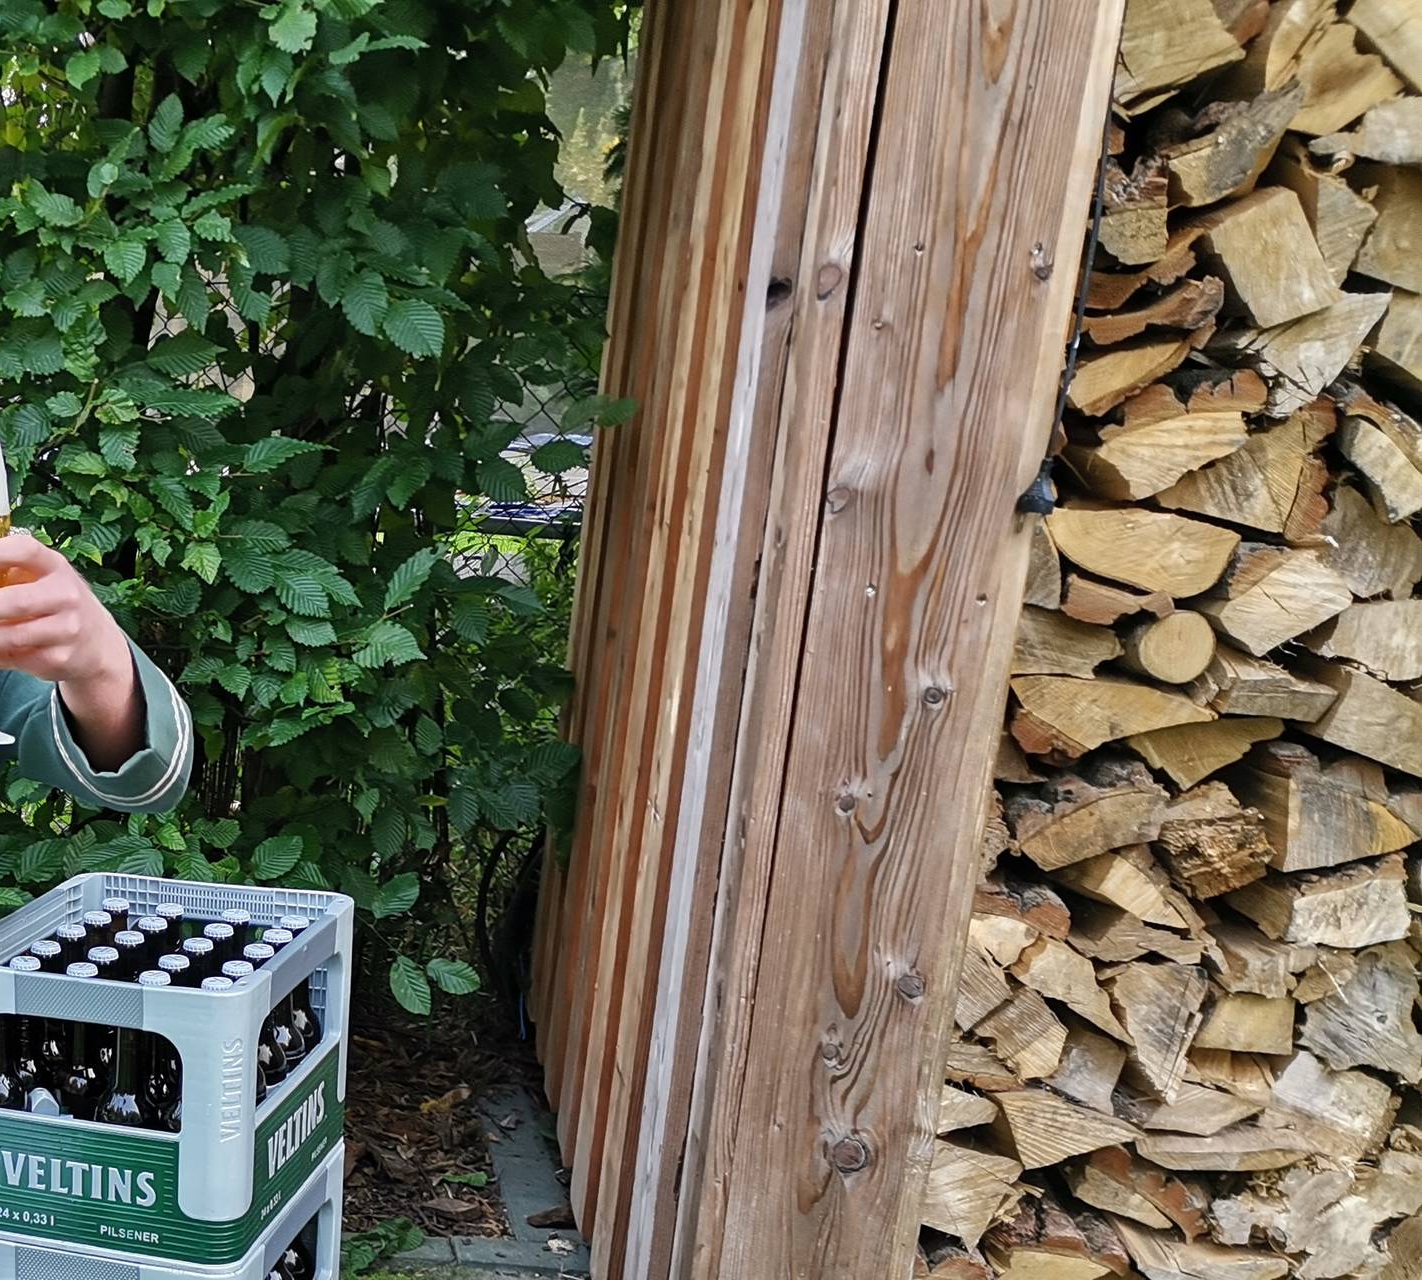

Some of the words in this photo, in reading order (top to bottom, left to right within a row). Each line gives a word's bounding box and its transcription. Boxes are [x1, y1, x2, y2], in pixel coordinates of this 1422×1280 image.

[220, 1039, 243, 1142] VELTINS
[268, 1081, 325, 1179] VELTINS
[1, 1150, 156, 1207] VELTINS
[12, 1211, 20, 1220] x
[23, 1211, 47, 1225] 0,33
[100, 1224, 159, 1243] PILSENER
